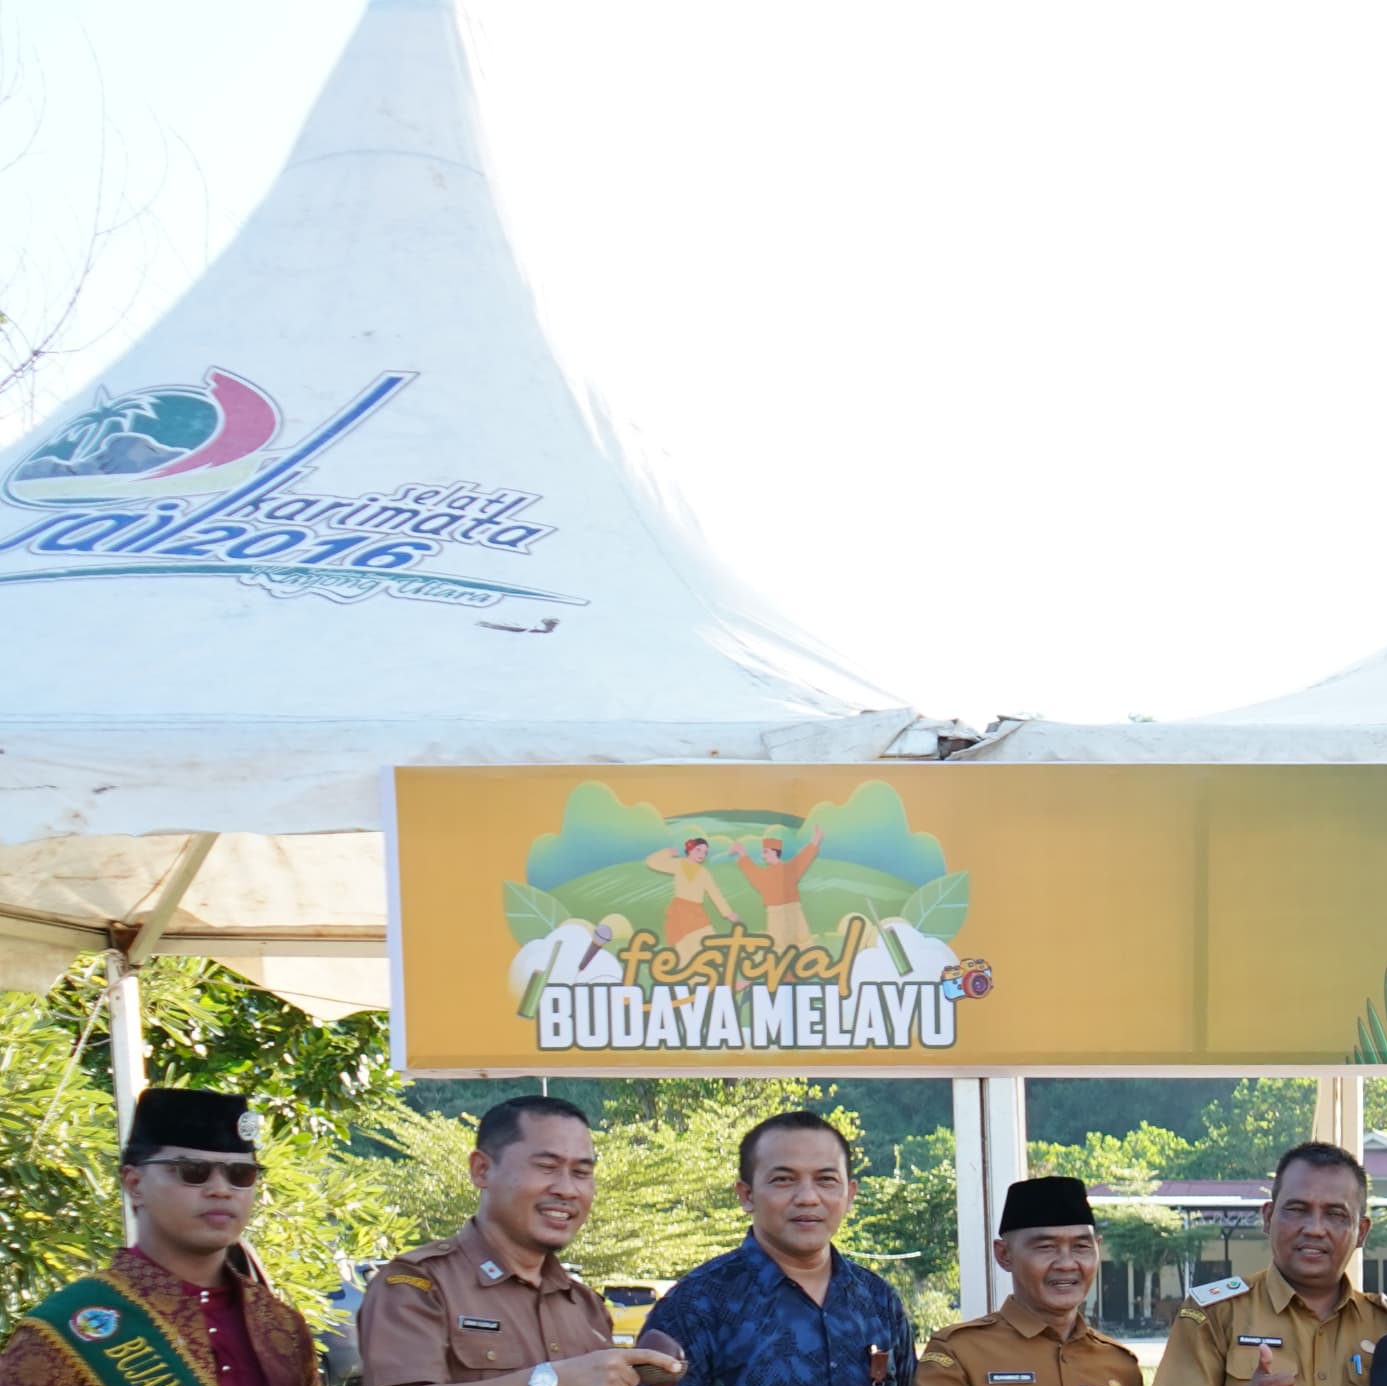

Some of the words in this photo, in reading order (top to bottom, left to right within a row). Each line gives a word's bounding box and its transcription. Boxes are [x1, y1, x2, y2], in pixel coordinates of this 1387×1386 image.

[223, 470, 543, 547] karimata
[152, 525, 433, 569] 2016
[619, 917, 865, 1003] festival
[540, 984, 742, 1049] BUDAYA
[750, 983, 955, 1049] MELAYU
